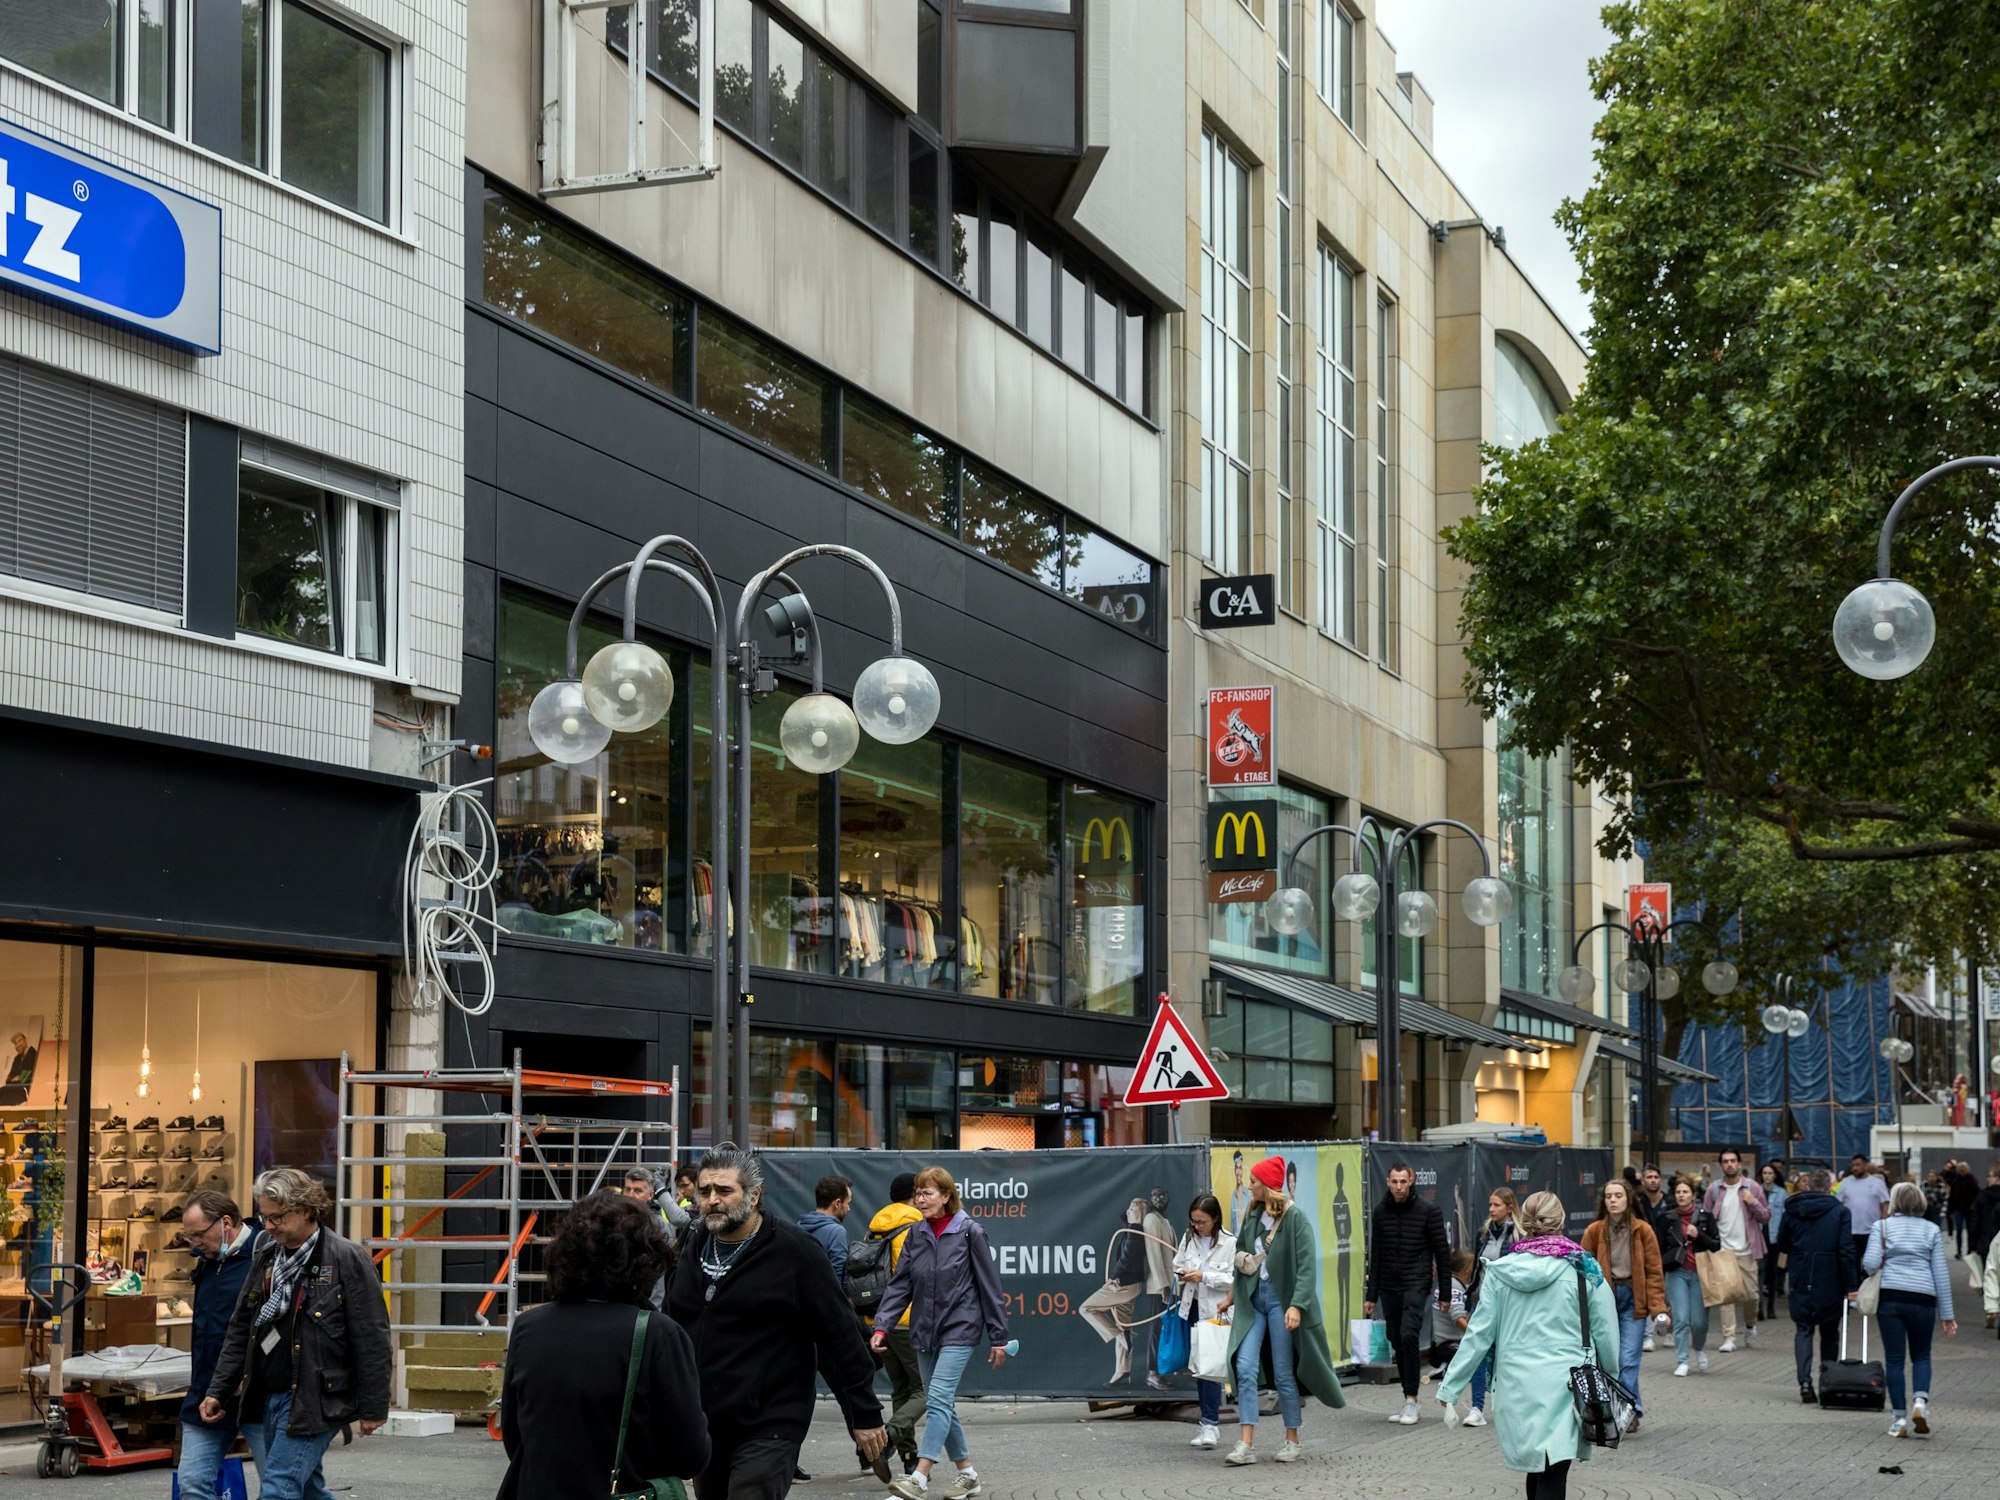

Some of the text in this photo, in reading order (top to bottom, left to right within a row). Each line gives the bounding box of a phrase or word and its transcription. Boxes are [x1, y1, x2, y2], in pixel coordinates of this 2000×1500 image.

[1209, 585, 1263, 617] C&A
[1211, 688, 1270, 703] FC-FANSHOP
[1234, 771, 1269, 783] 4. ETAGE
[1219, 874, 1265, 897] McCafé
[954, 1177, 1029, 1199] alando
[972, 1201, 1028, 1218] outlet
[989, 1244, 1096, 1275] ENING
